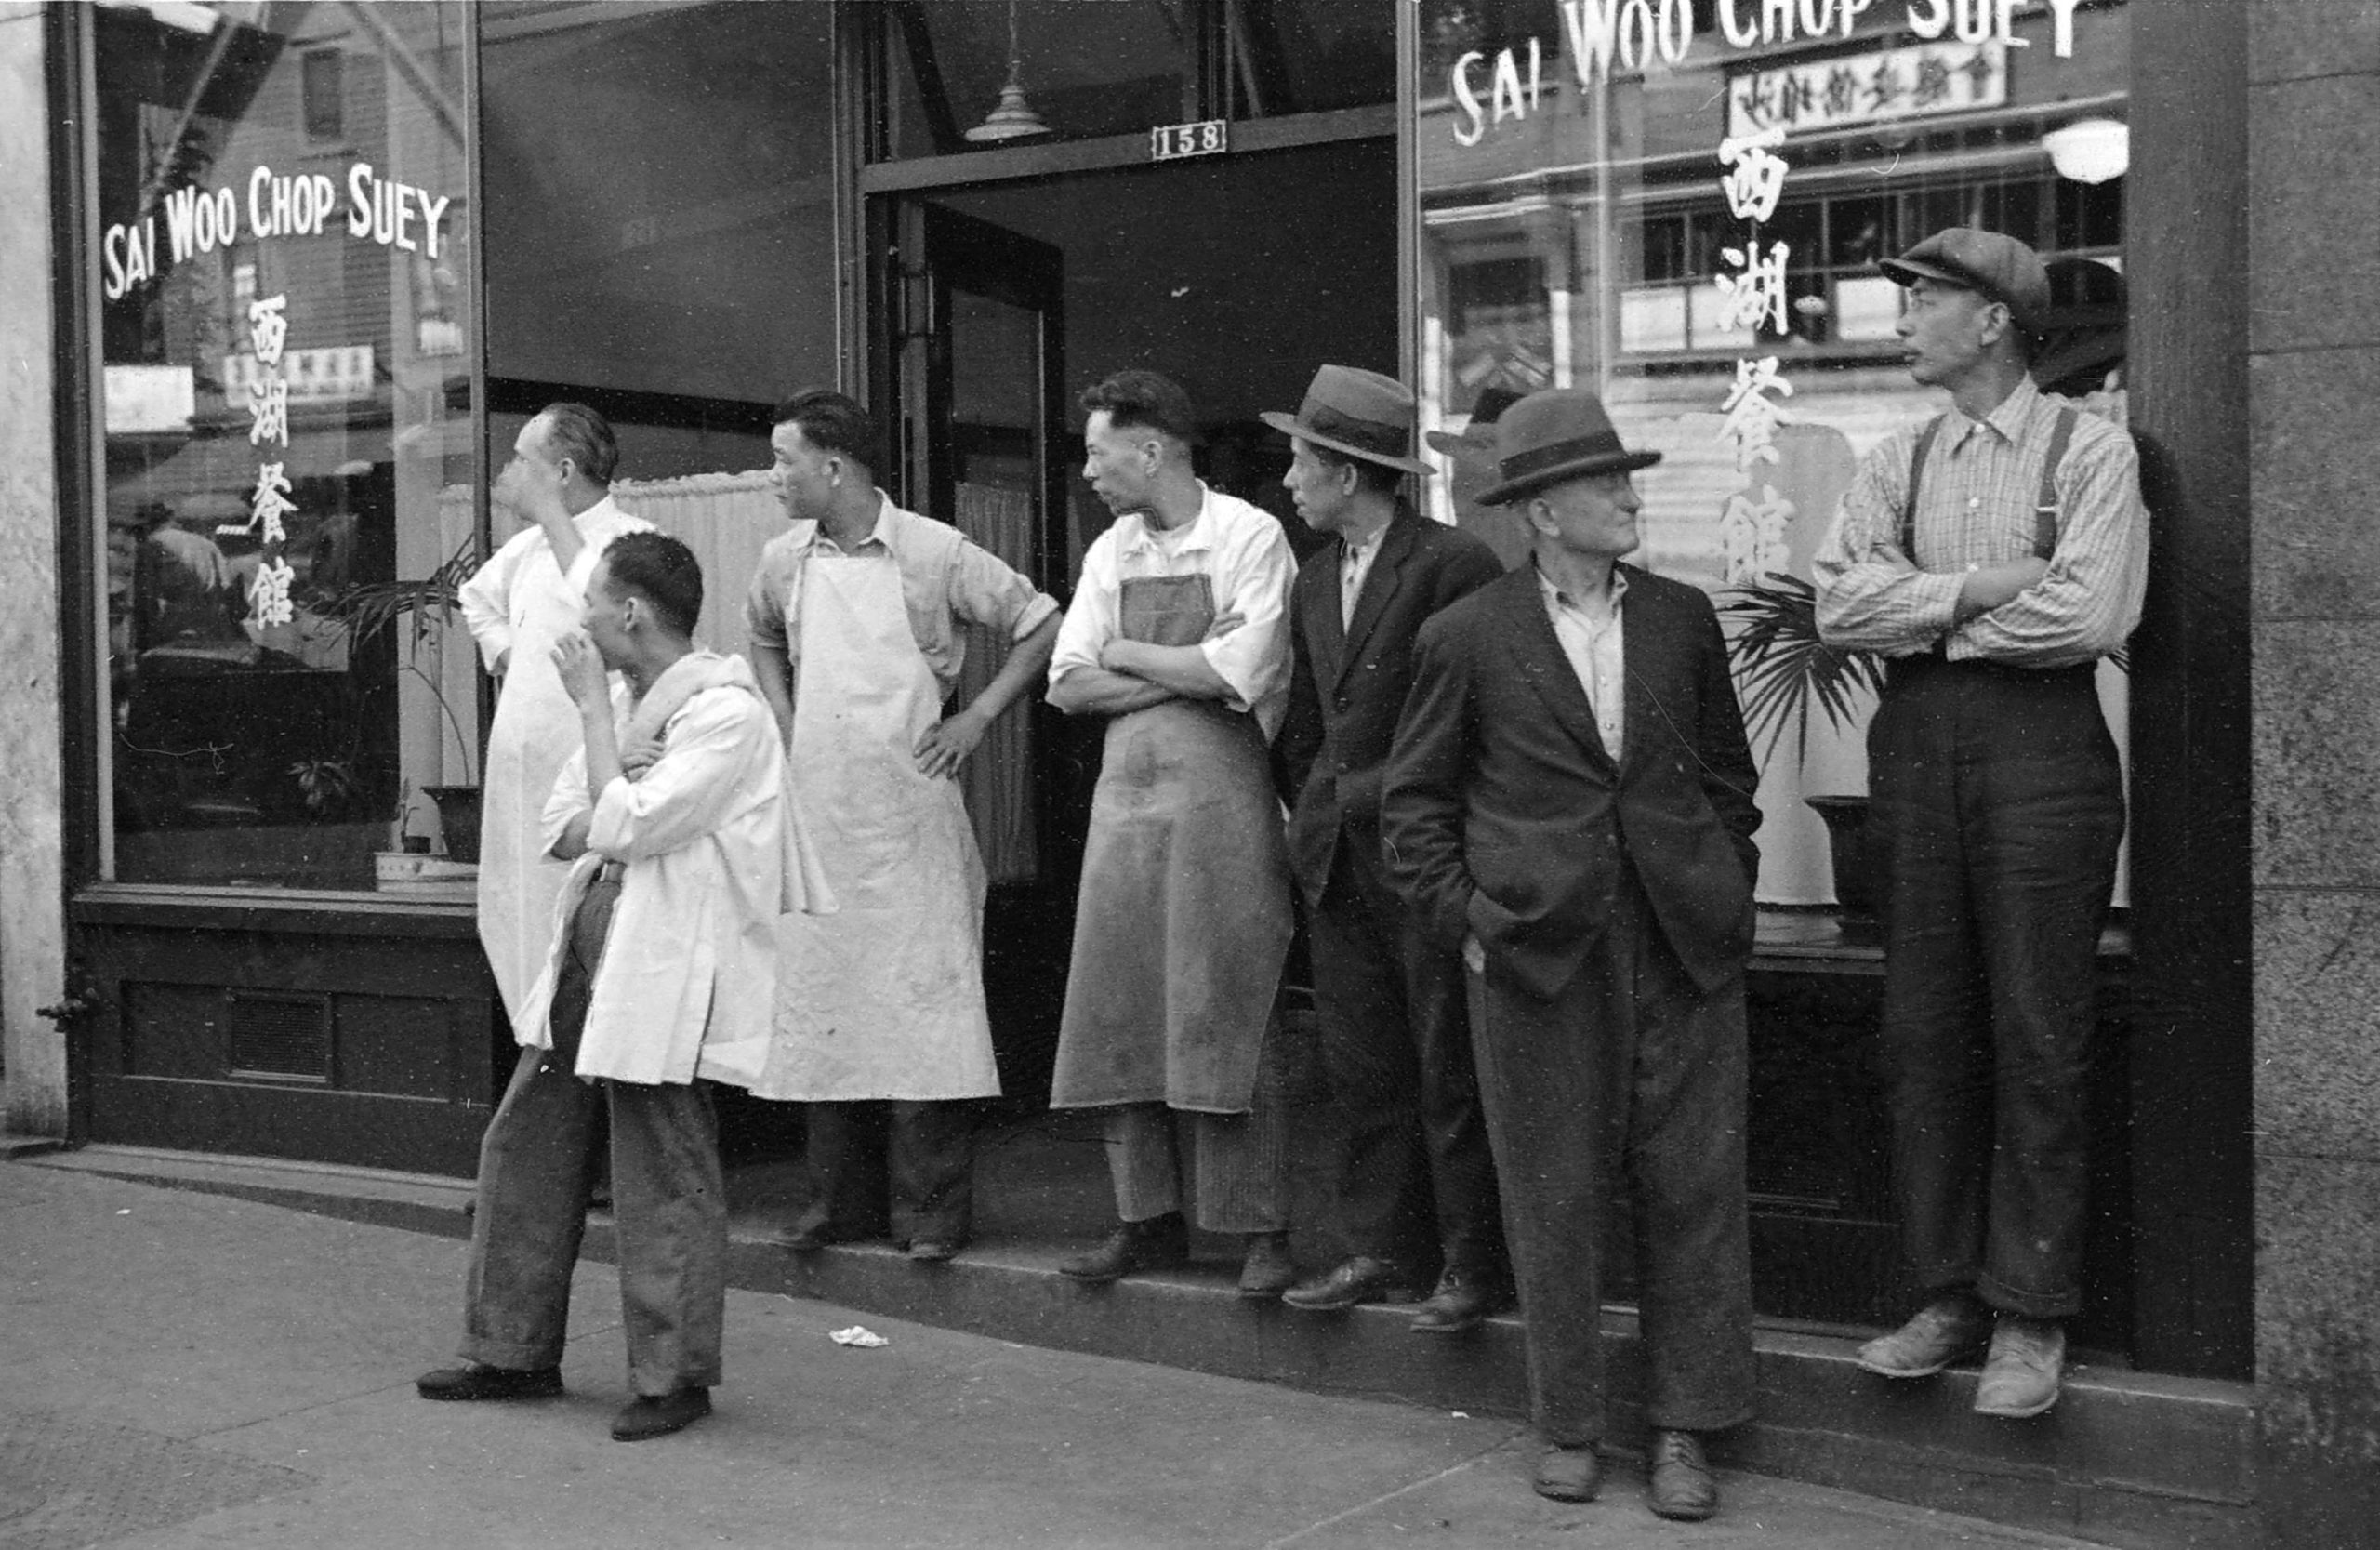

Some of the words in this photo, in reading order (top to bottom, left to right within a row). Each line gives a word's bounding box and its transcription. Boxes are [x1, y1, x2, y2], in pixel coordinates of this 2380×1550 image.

[1160, 125, 1218, 155] 158
[1452, 36, 1540, 147] SAI
[1564, 0, 1694, 86] WOO
[104, 217, 155, 299] SAI
[165, 185, 237, 263] WOO
[248, 165, 336, 238] CHOP
[348, 162, 450, 259] SUEY
